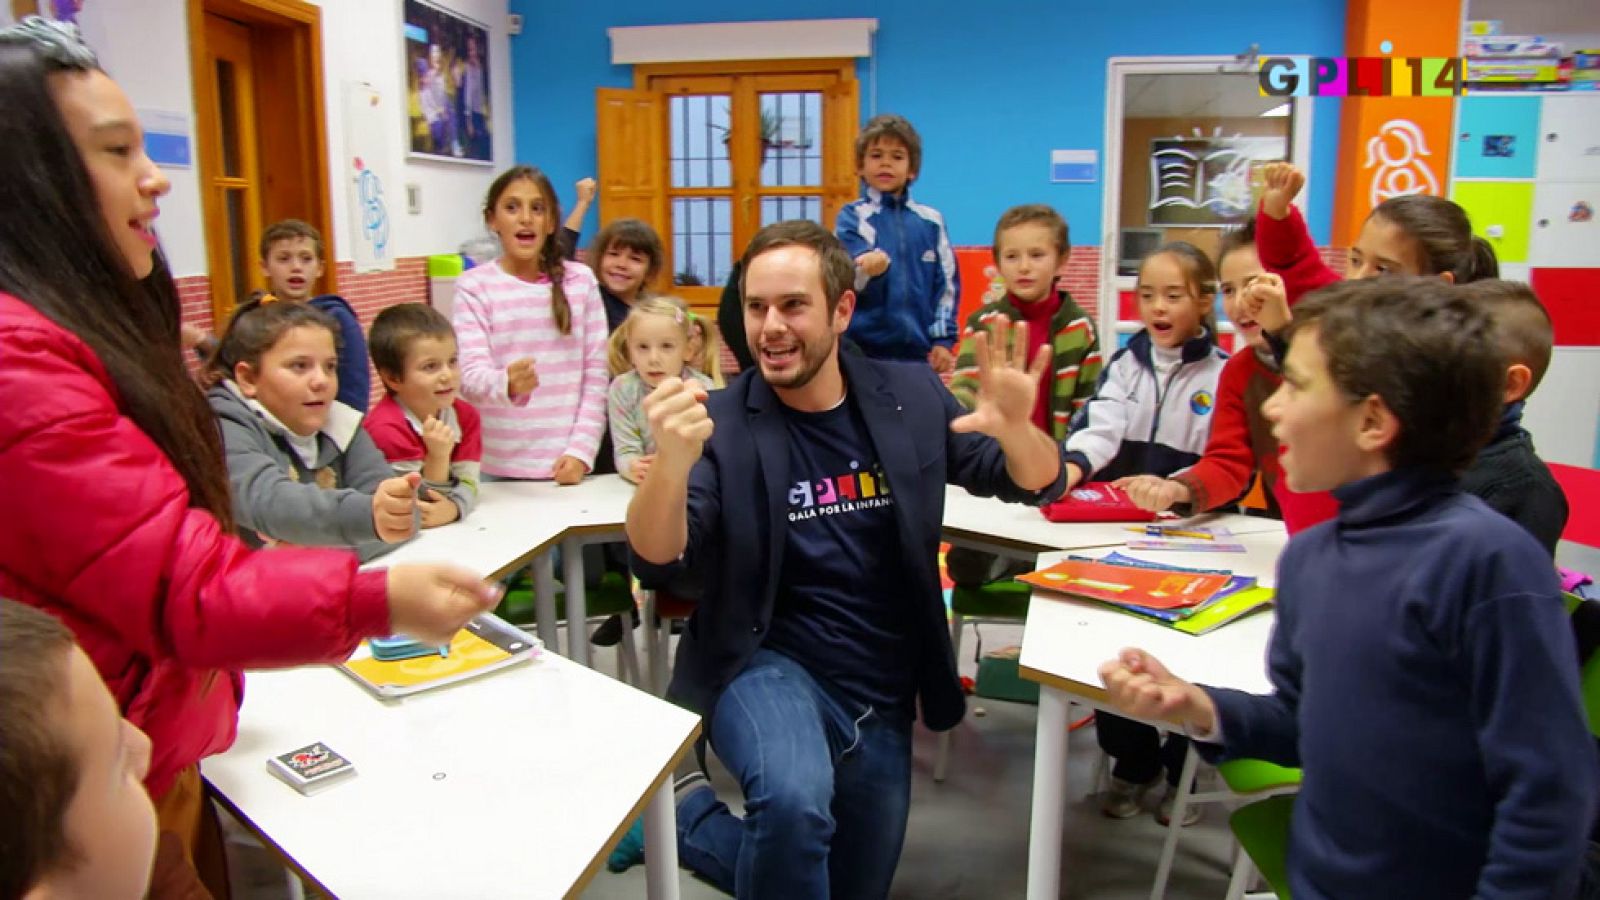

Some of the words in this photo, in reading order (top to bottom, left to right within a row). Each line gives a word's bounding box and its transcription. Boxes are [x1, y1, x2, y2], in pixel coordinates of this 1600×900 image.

[787, 511, 816, 522] GALA
[819, 505, 841, 516] POR
[842, 502, 855, 513] LA
